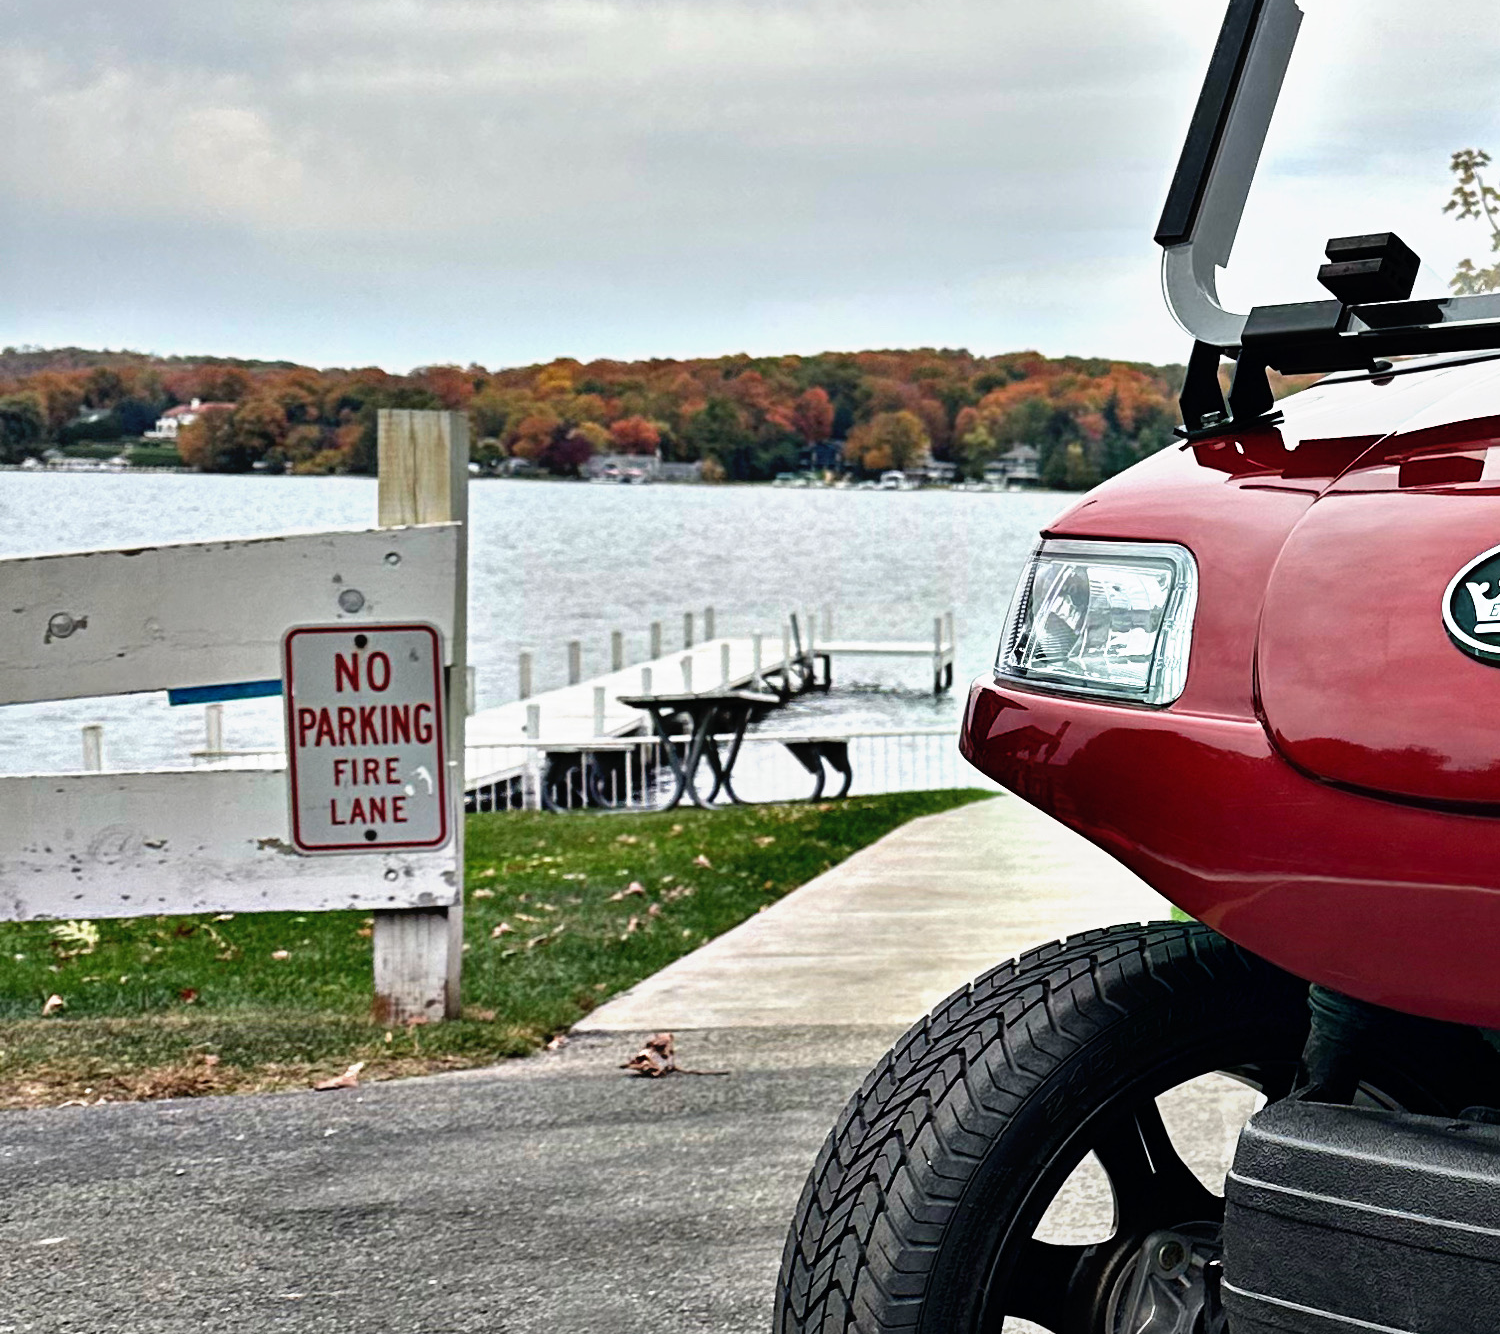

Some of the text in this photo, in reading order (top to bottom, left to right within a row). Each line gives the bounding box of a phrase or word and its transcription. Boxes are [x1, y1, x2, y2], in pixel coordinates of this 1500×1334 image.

[335, 651, 391, 692] NO
[298, 703, 433, 747] PARKING
[333, 758, 401, 786] FIRE
[330, 796, 408, 825] LANE
